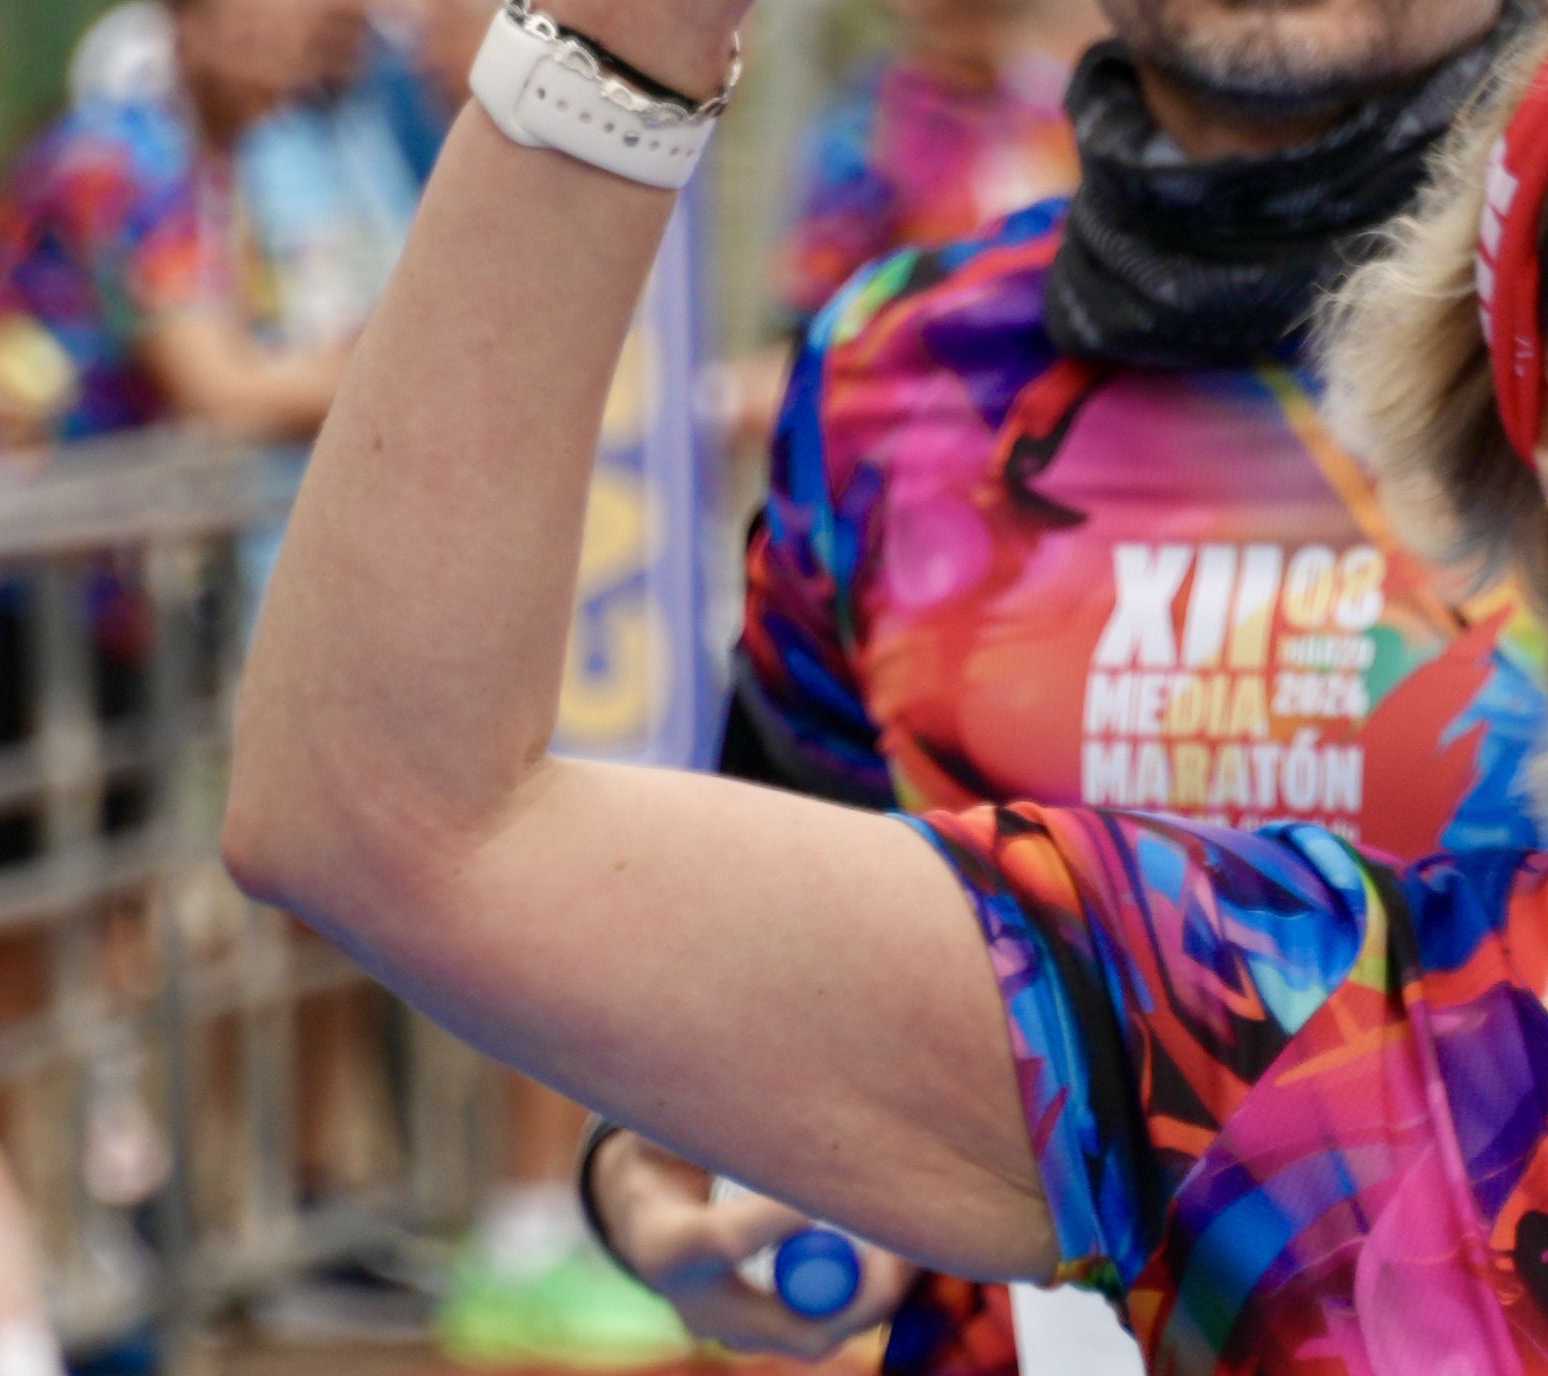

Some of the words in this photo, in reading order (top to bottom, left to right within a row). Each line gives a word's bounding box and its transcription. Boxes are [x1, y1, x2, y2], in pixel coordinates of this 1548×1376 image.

[1094, 543, 1284, 667] XII
[1084, 671, 1270, 738] MEDIA
[1082, 727, 1365, 811] MARATÓN
